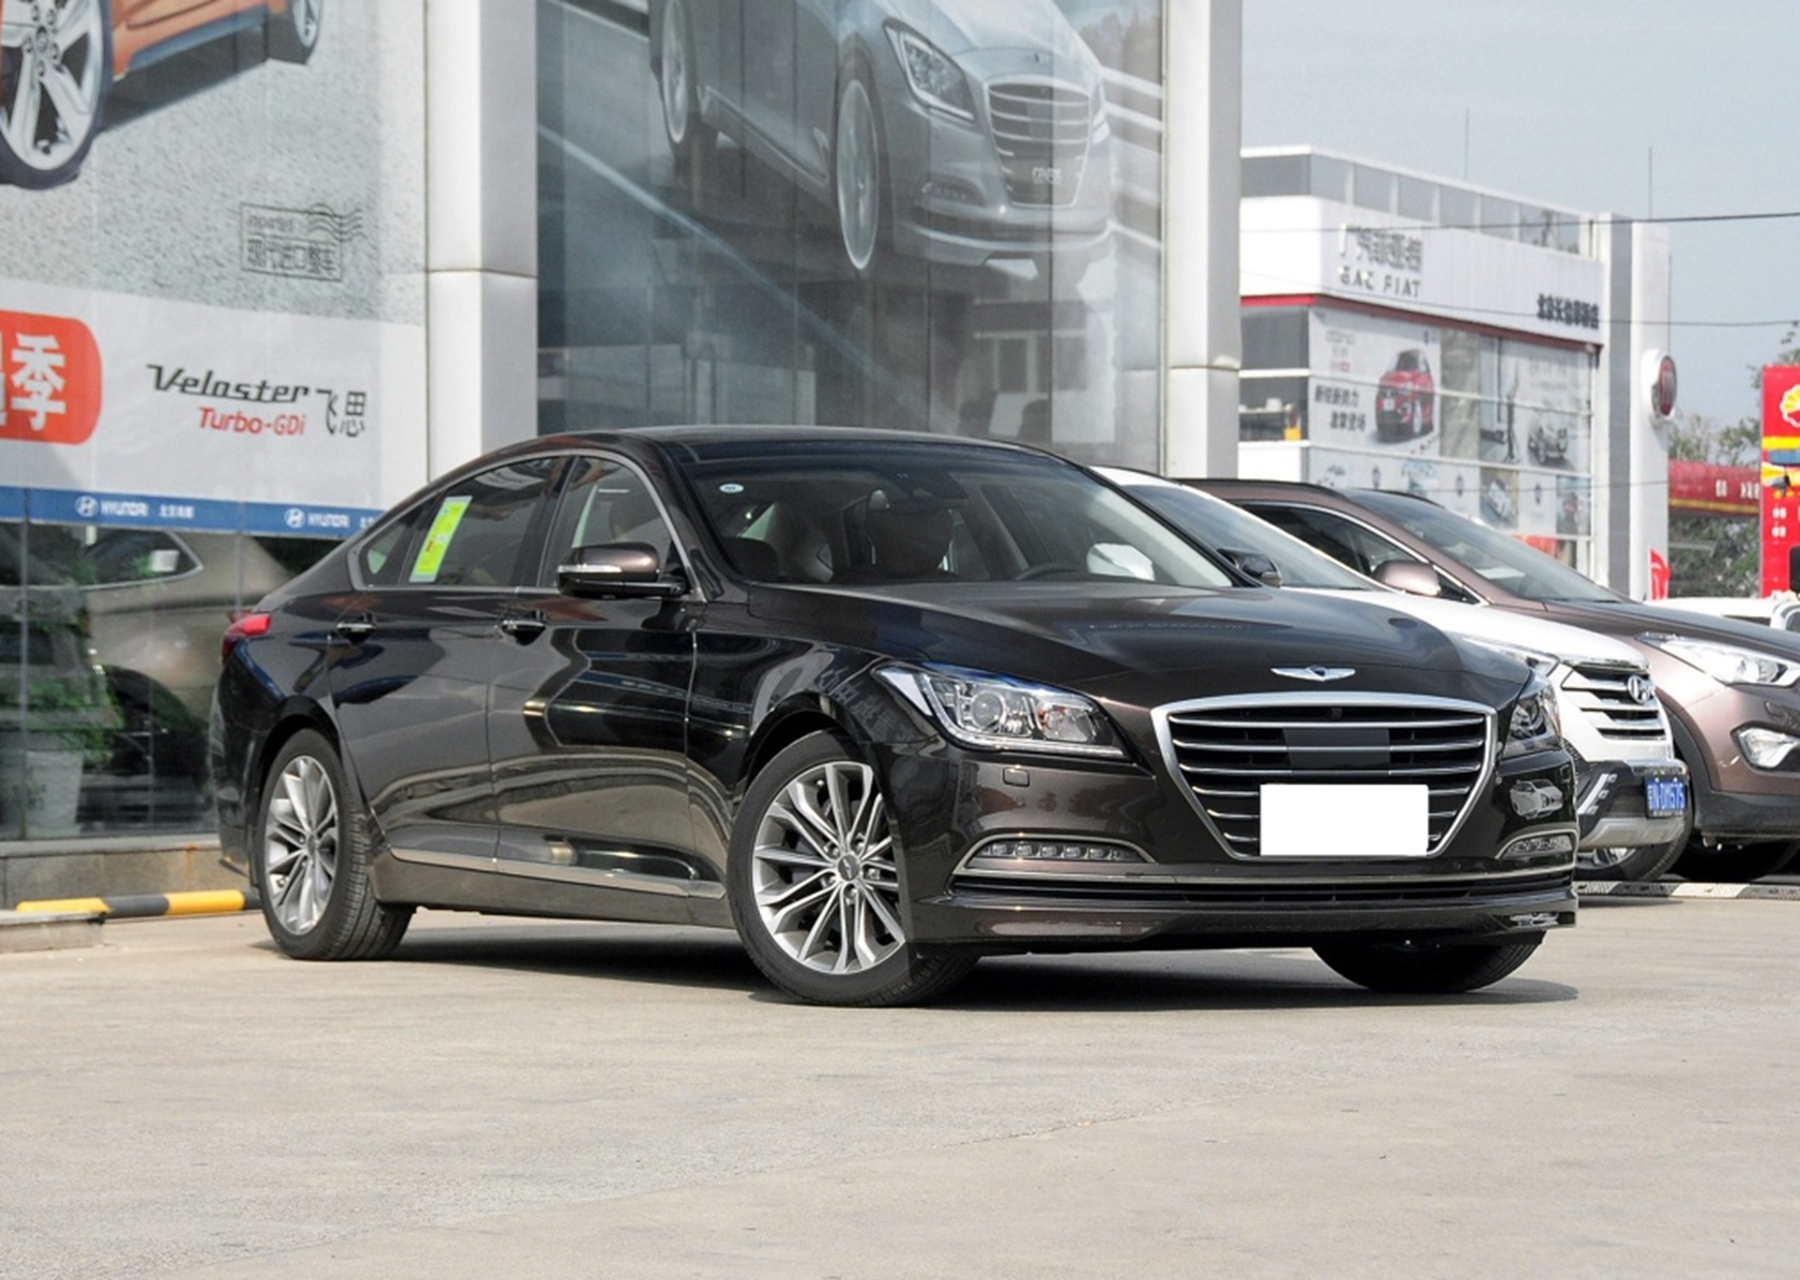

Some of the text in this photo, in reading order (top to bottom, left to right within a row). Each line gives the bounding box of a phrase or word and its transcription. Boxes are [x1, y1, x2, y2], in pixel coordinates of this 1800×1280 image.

[1338, 265, 1422, 299] GAC FIAT
[0, 330, 67, 431] 季
[147, 364, 366, 438] Veloster 飞思
[199, 405, 307, 436] Turbo-GDi
